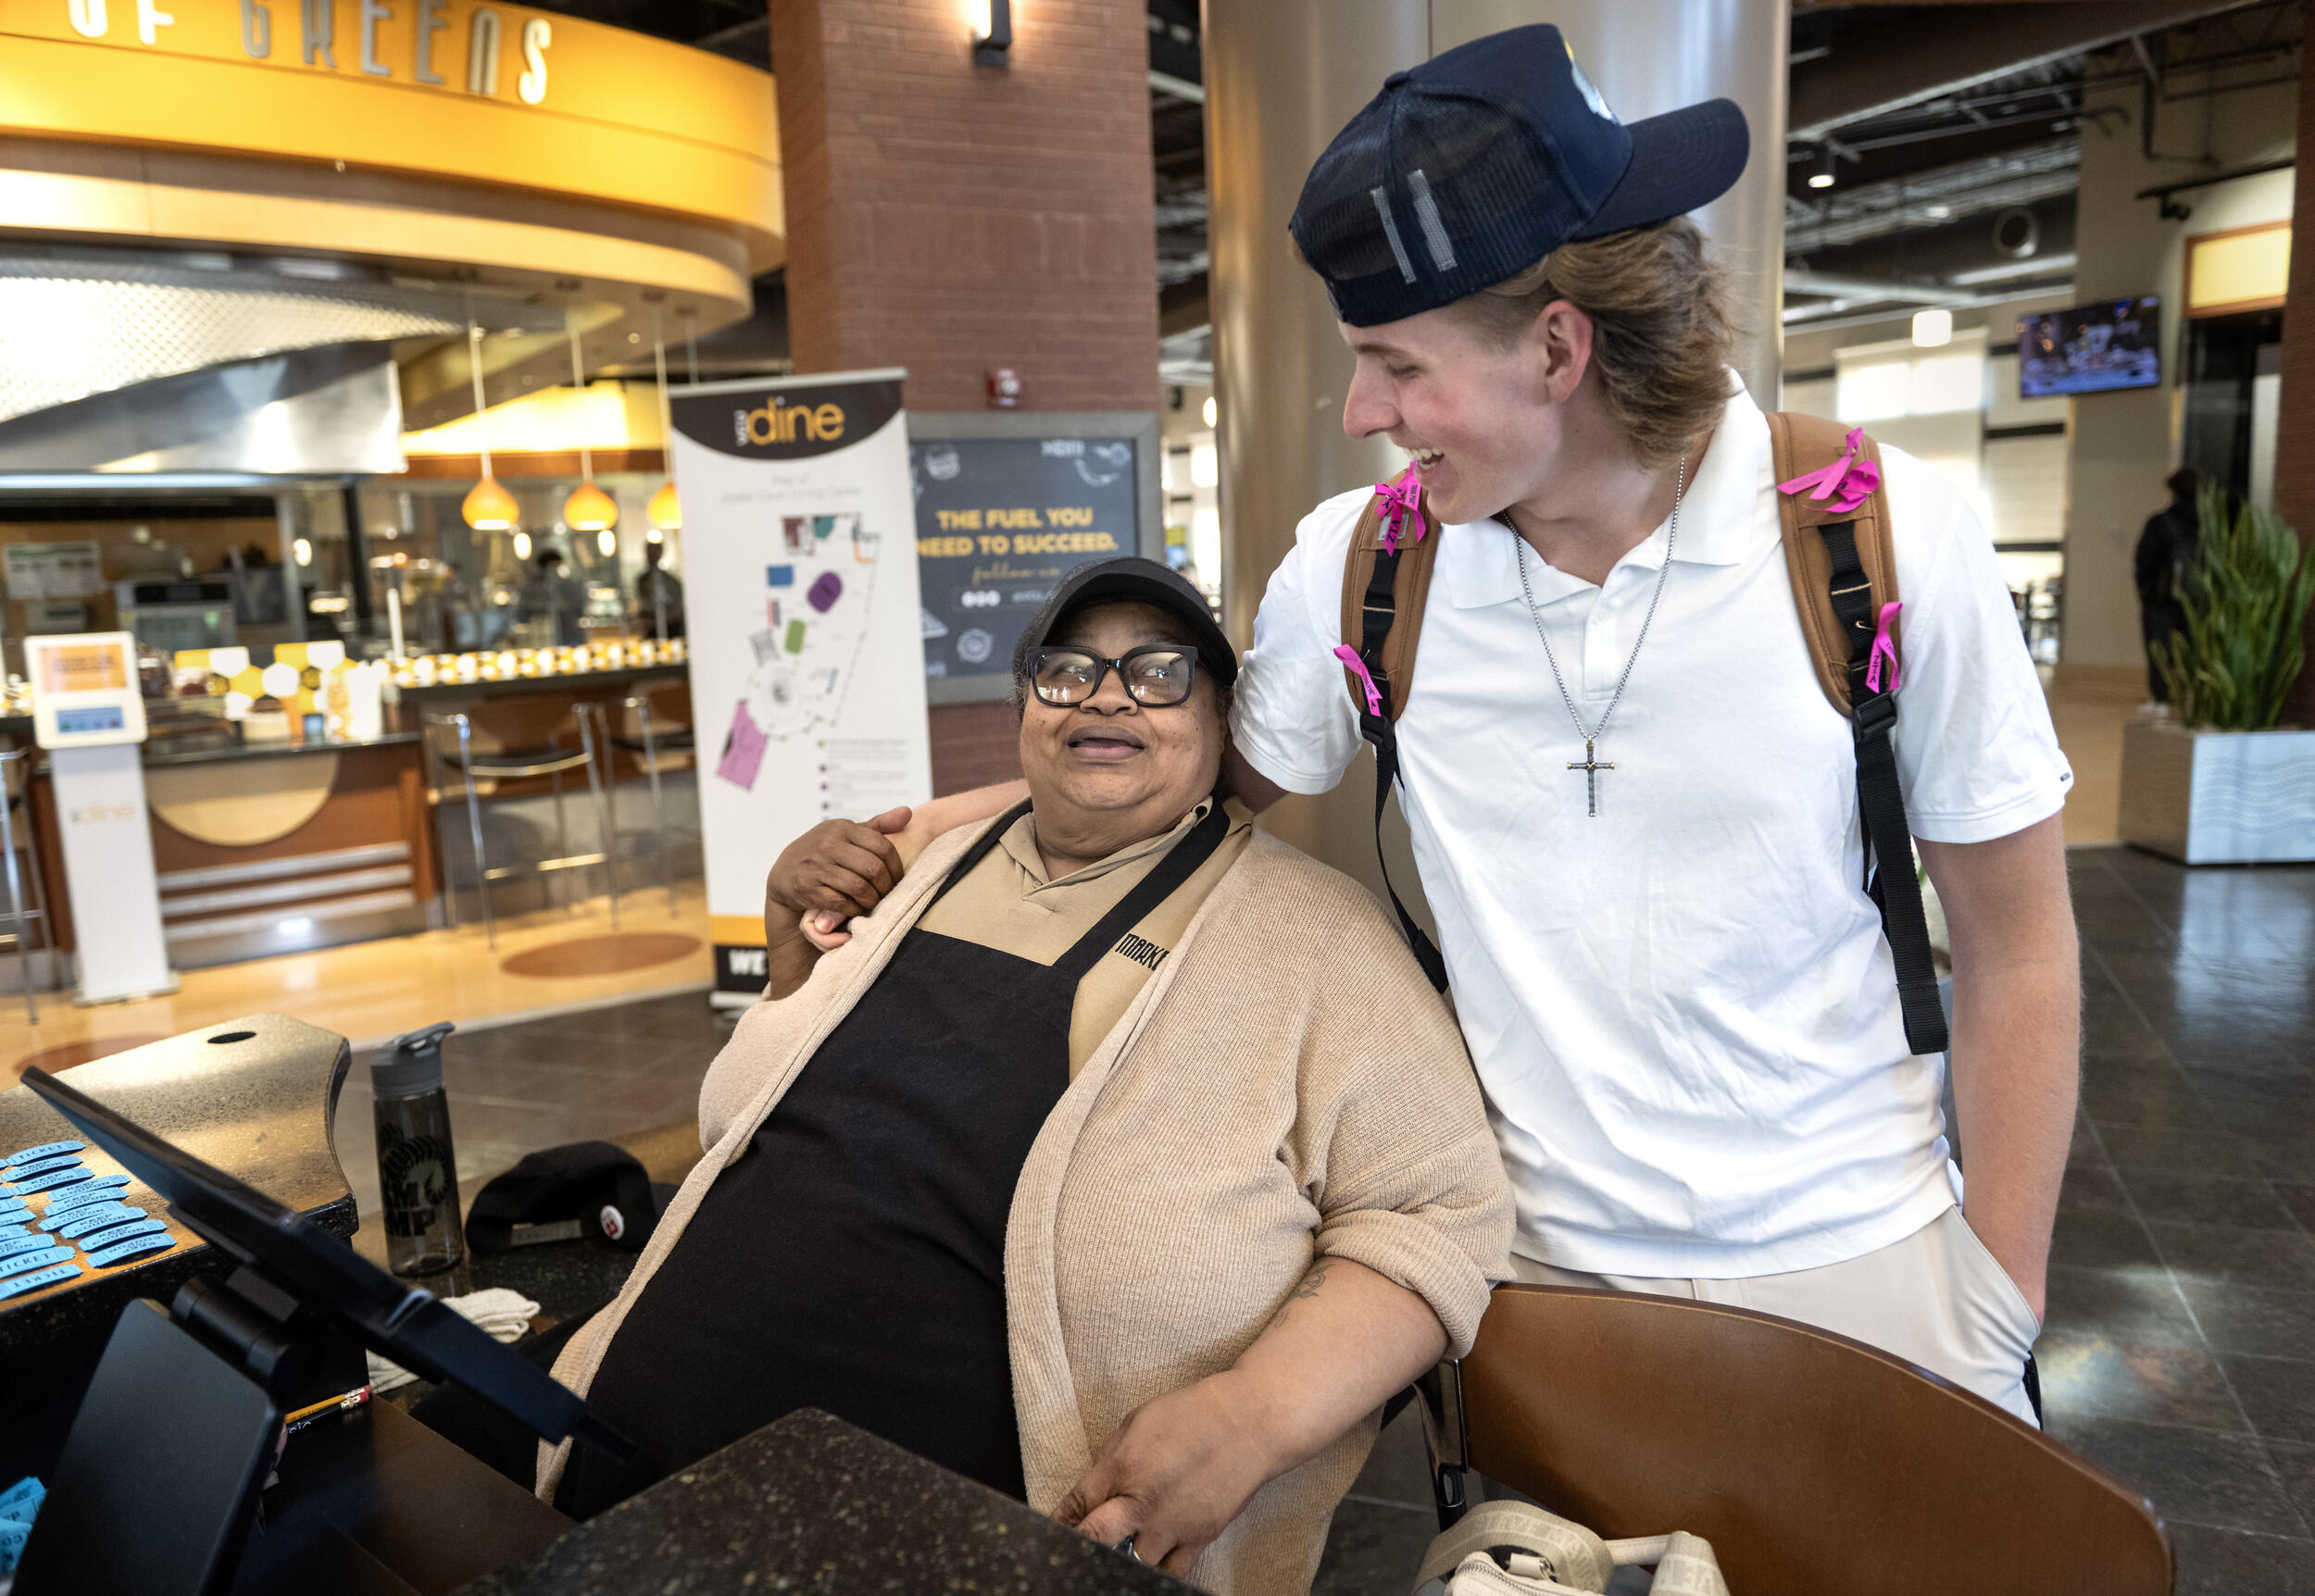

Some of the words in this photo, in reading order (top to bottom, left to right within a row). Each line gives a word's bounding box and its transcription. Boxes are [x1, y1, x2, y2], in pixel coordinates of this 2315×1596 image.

[238, 0, 553, 106] GREENS
[746, 395, 845, 446] dine
[936, 509, 982, 531] THE
[984, 508, 1044, 530] FUEL
[1045, 506, 1094, 528] YOU
[915, 535, 975, 558] NEED
[976, 534, 1010, 555] TO
[1869, 654, 1881, 683] ZTA
[19, 1144, 62, 1160] TICKET
